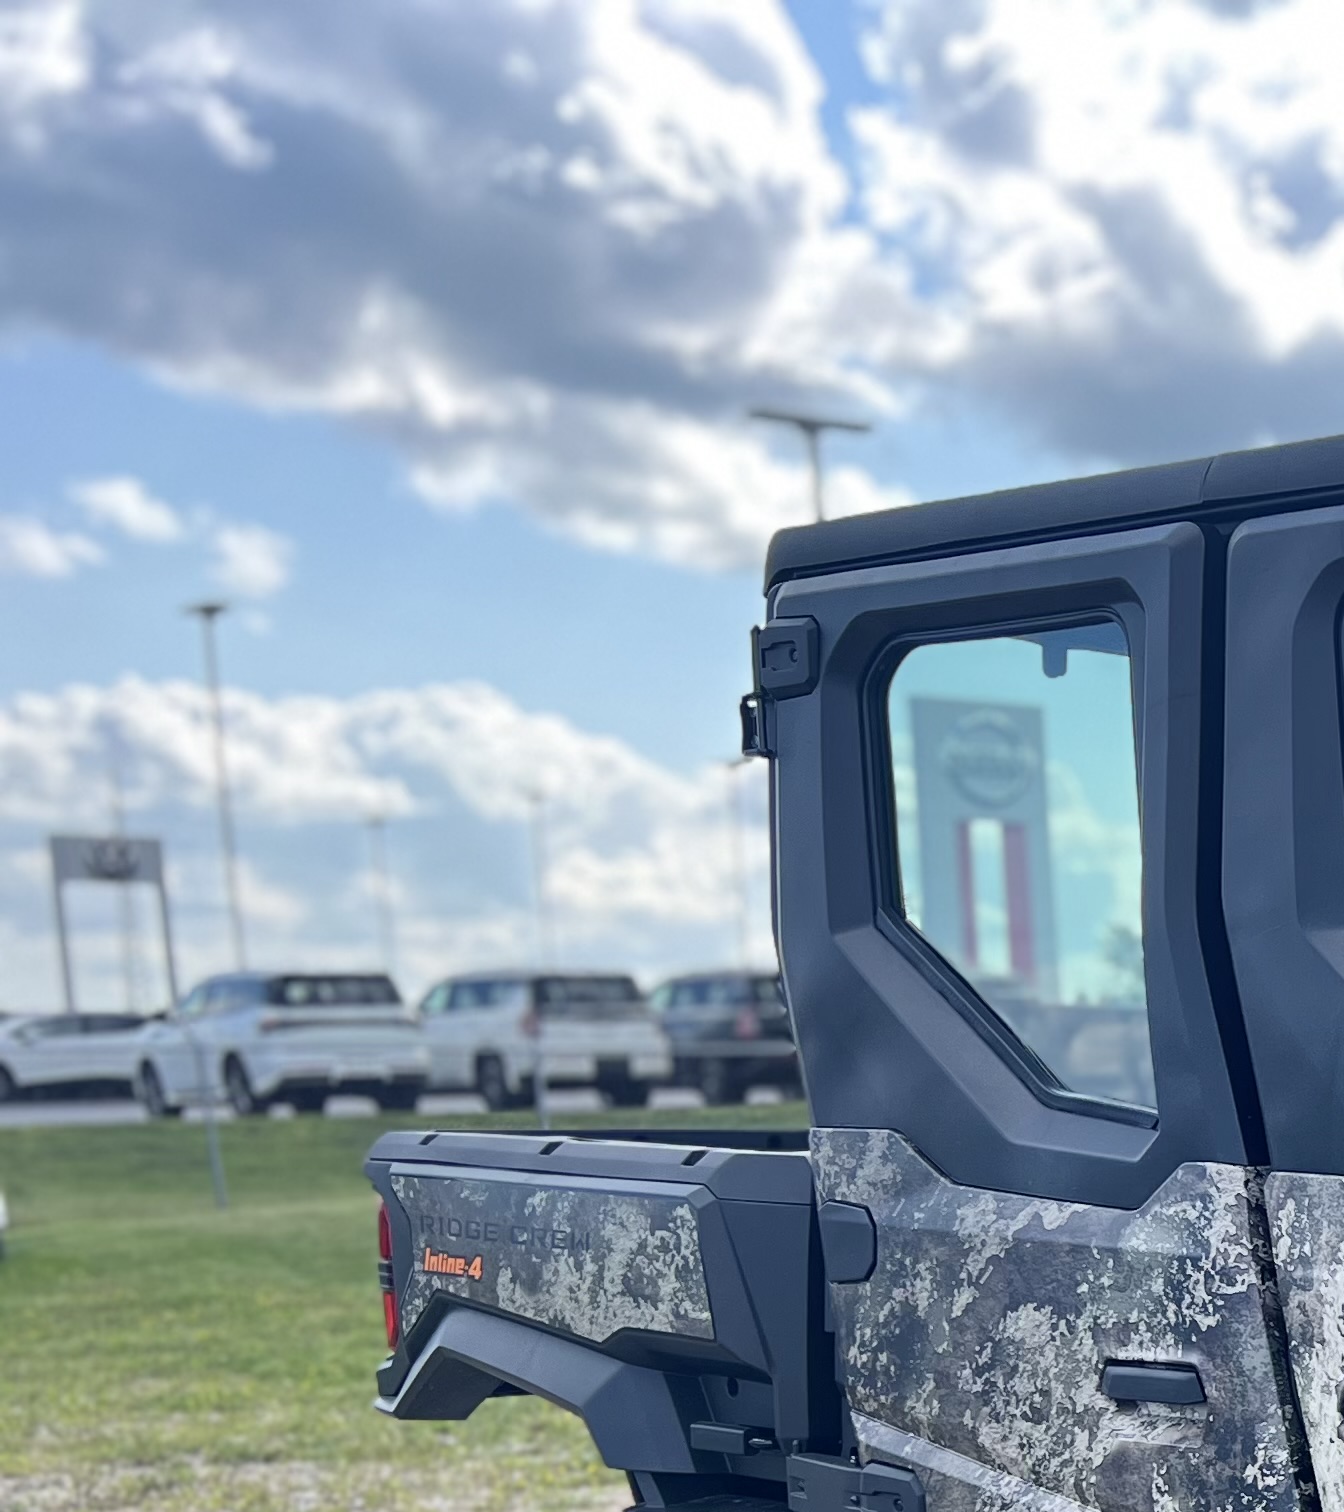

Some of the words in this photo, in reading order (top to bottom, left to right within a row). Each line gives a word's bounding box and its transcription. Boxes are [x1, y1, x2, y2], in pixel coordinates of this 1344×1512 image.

[420, 1214, 499, 1243] RIDGE
[510, 1224, 591, 1252] CREW
[423, 1246, 484, 1281] Inline-4
